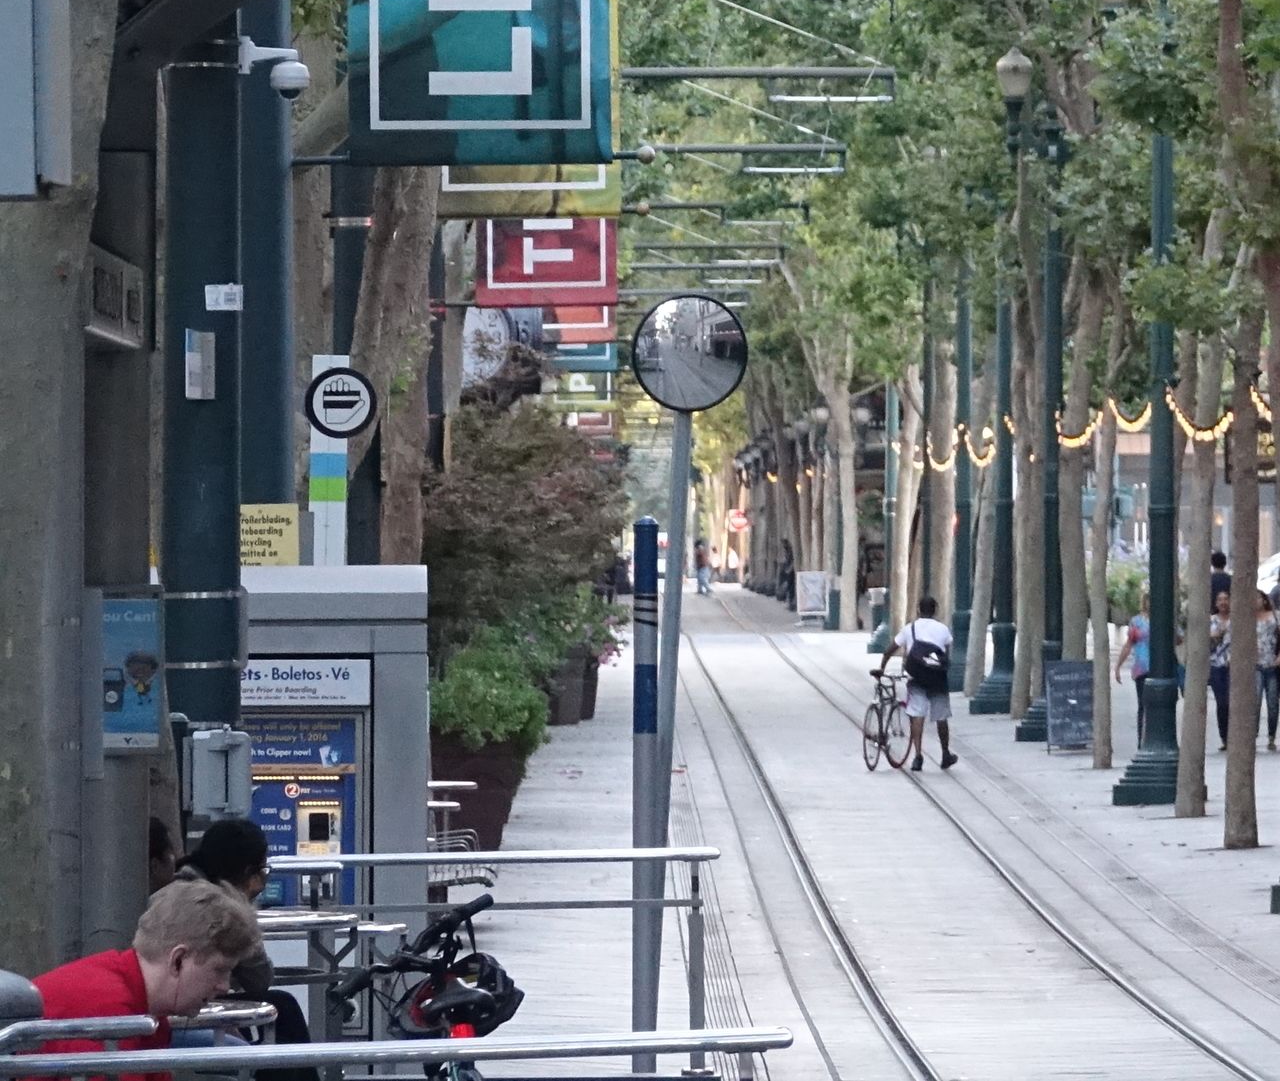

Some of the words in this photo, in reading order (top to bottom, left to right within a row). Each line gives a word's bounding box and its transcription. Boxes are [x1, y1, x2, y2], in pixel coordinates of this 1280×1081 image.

[241, 526, 283, 537] teboarding
[239, 549, 266, 558] mitted
[103, 612, 121, 622] ou
[240, 669, 262, 681] ets
[271, 666, 322, 681] Boletos
[331, 667, 350, 681] Vé
[256, 686, 274, 694] Prior
[275, 686, 283, 694] to
[284, 686, 317, 695] Boarding
[264, 733, 297, 744] January
[307, 733, 328, 742] 2016
[257, 748, 265, 756] to
[266, 747, 292, 758] Clipper
[293, 748, 312, 756] now!
